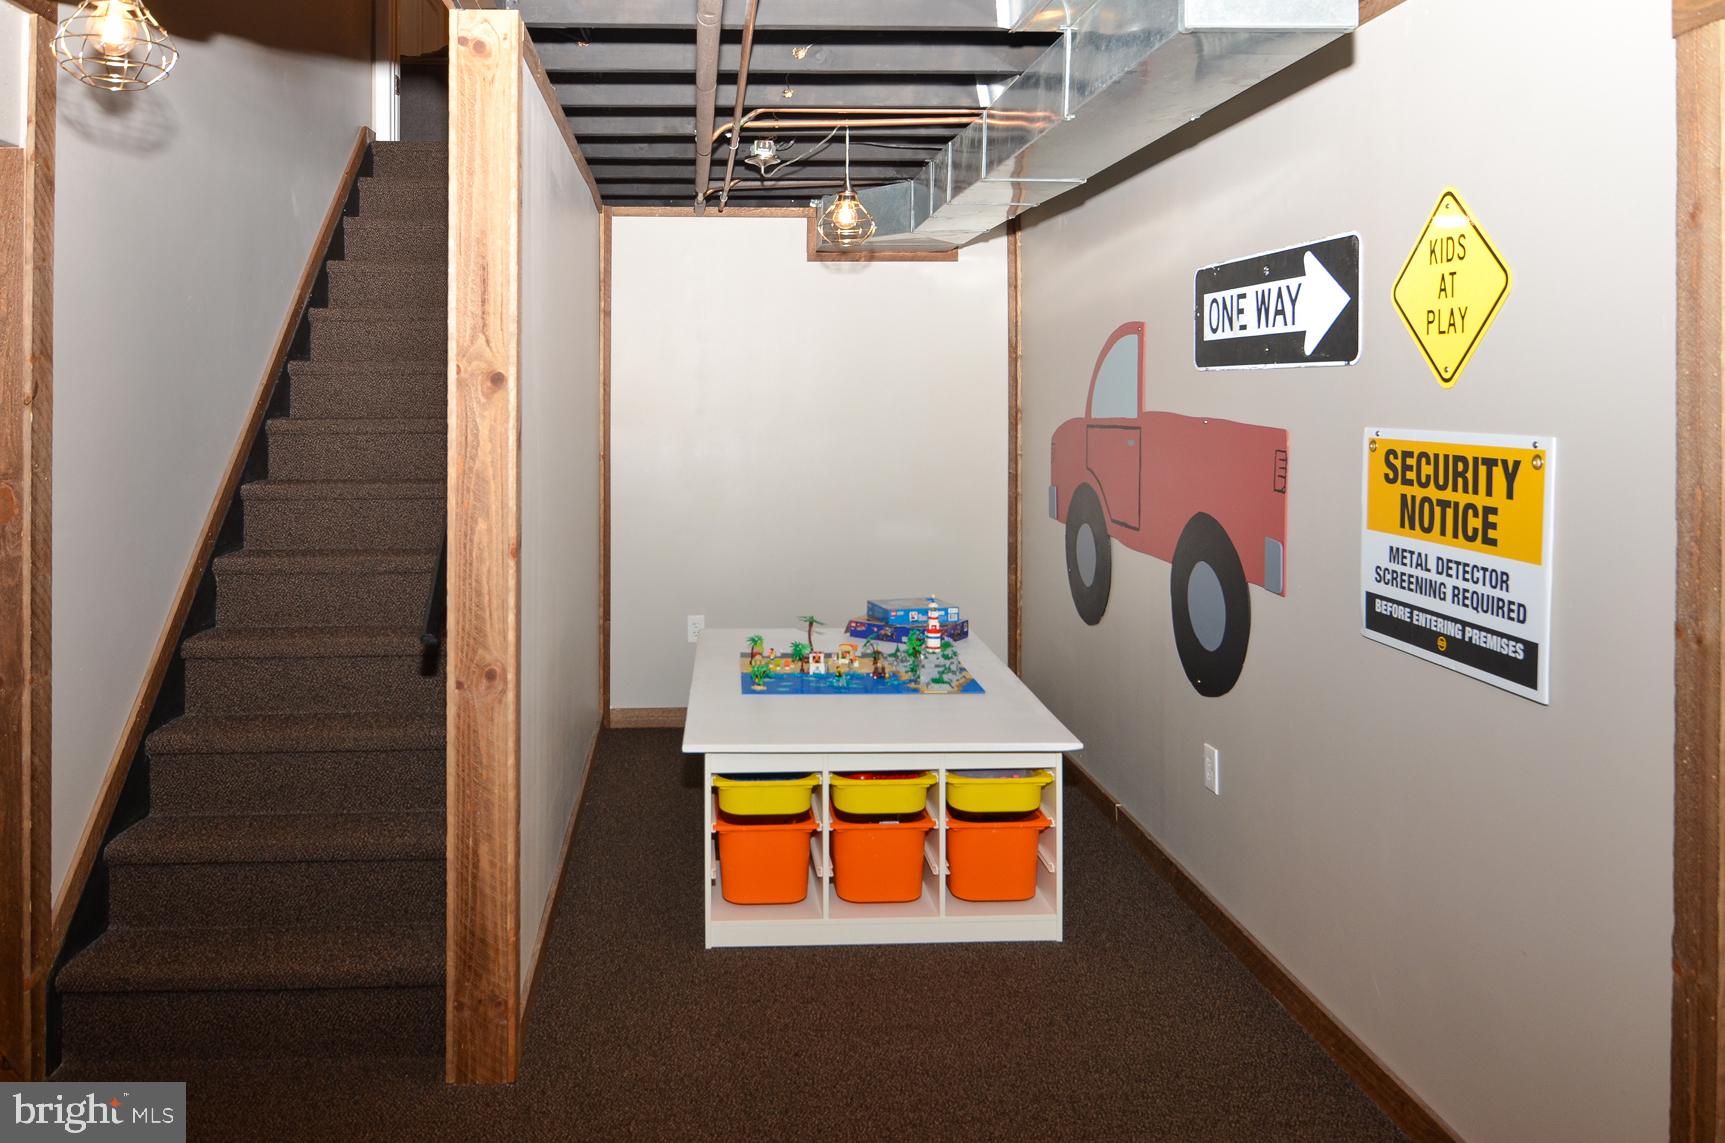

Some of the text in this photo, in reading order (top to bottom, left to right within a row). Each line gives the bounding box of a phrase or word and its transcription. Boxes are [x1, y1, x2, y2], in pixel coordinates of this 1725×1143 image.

[1429, 234, 1467, 265] KIDS
[1209, 283, 1302, 334] ONE WAY
[1438, 272, 1457, 299] AT
[1426, 306, 1469, 335] PLAY
[1383, 448, 1522, 500] SECURITY
[1399, 493, 1499, 548] NOTICE
[1389, 545, 1510, 593] METAL DETECTOR
[1374, 565, 1527, 625] SCREENING REQUIRED
[1375, 598, 1411, 622] BEFORE
[1413, 610, 1463, 640] ENTERING
[1465, 626, 1525, 660] PREMISES
